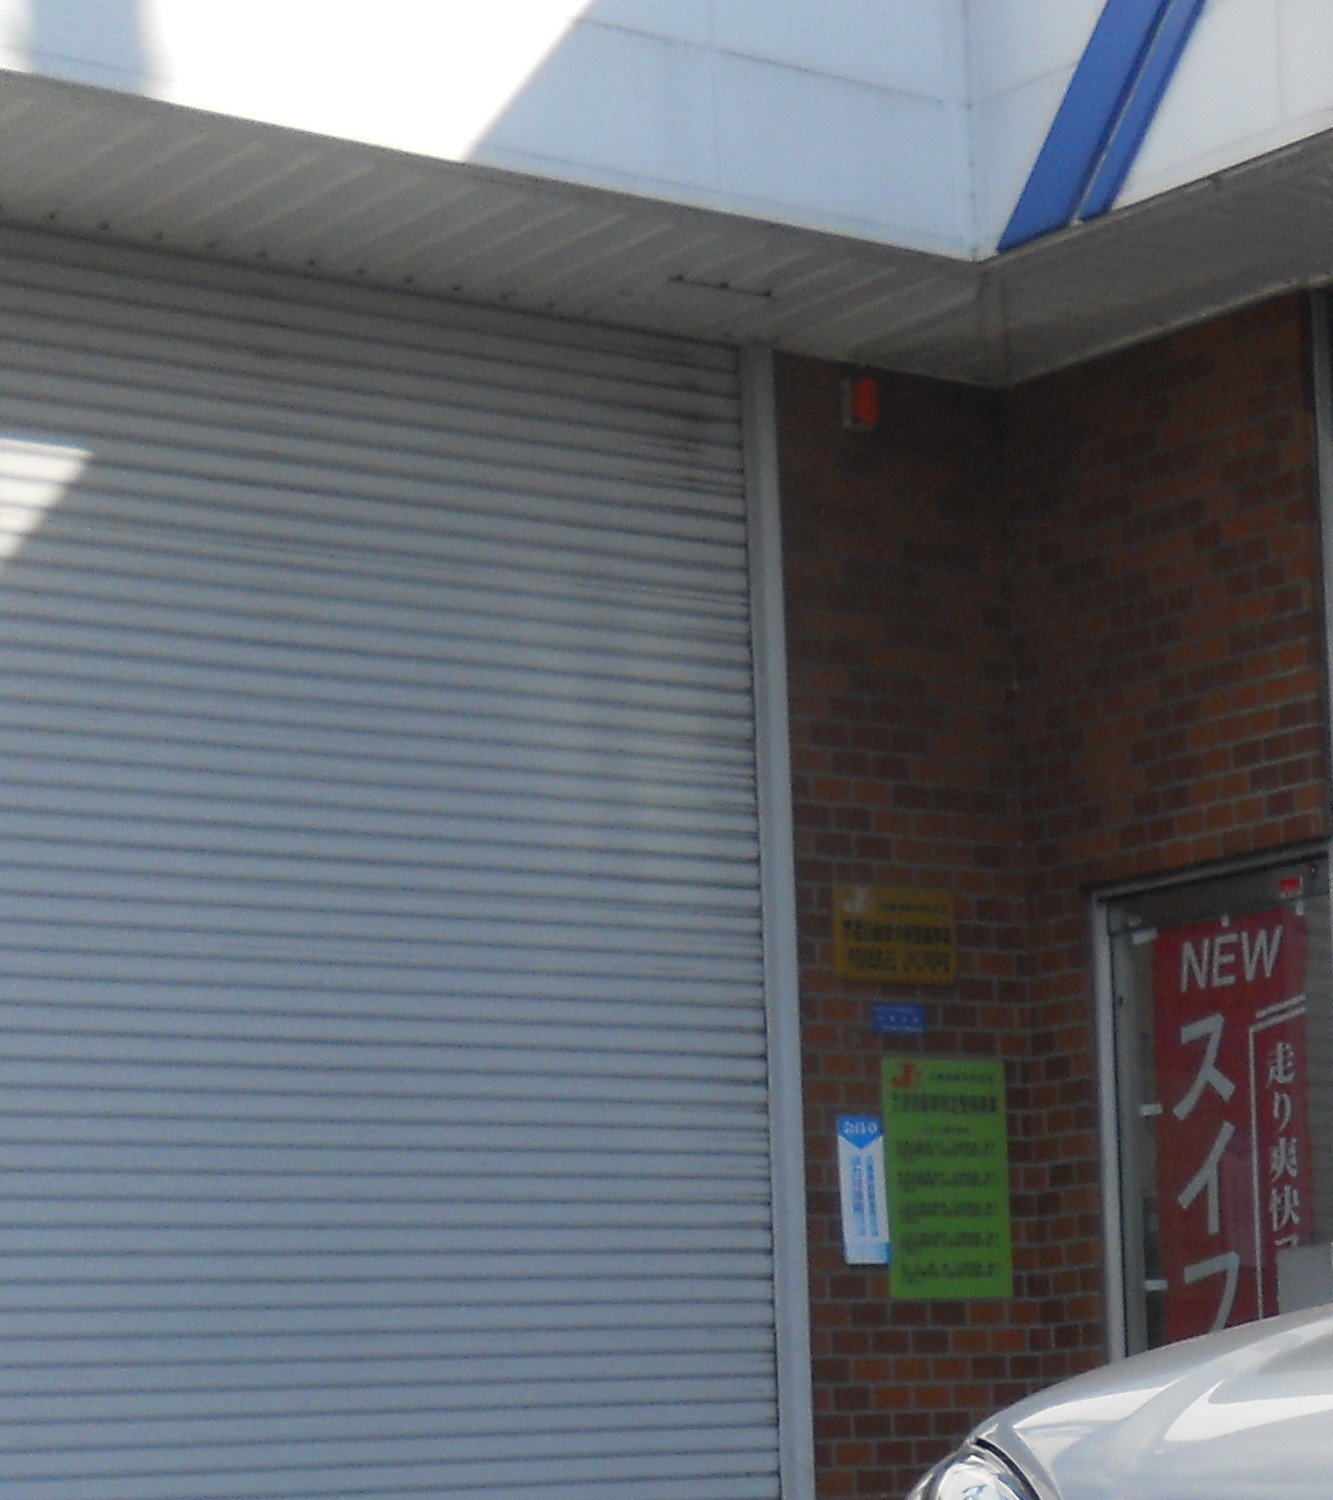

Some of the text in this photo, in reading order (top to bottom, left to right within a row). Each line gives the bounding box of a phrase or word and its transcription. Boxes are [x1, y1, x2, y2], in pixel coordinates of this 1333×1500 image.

[1181, 925, 1284, 994] NEW
[1266, 1041, 1301, 1250] 走り爽快
